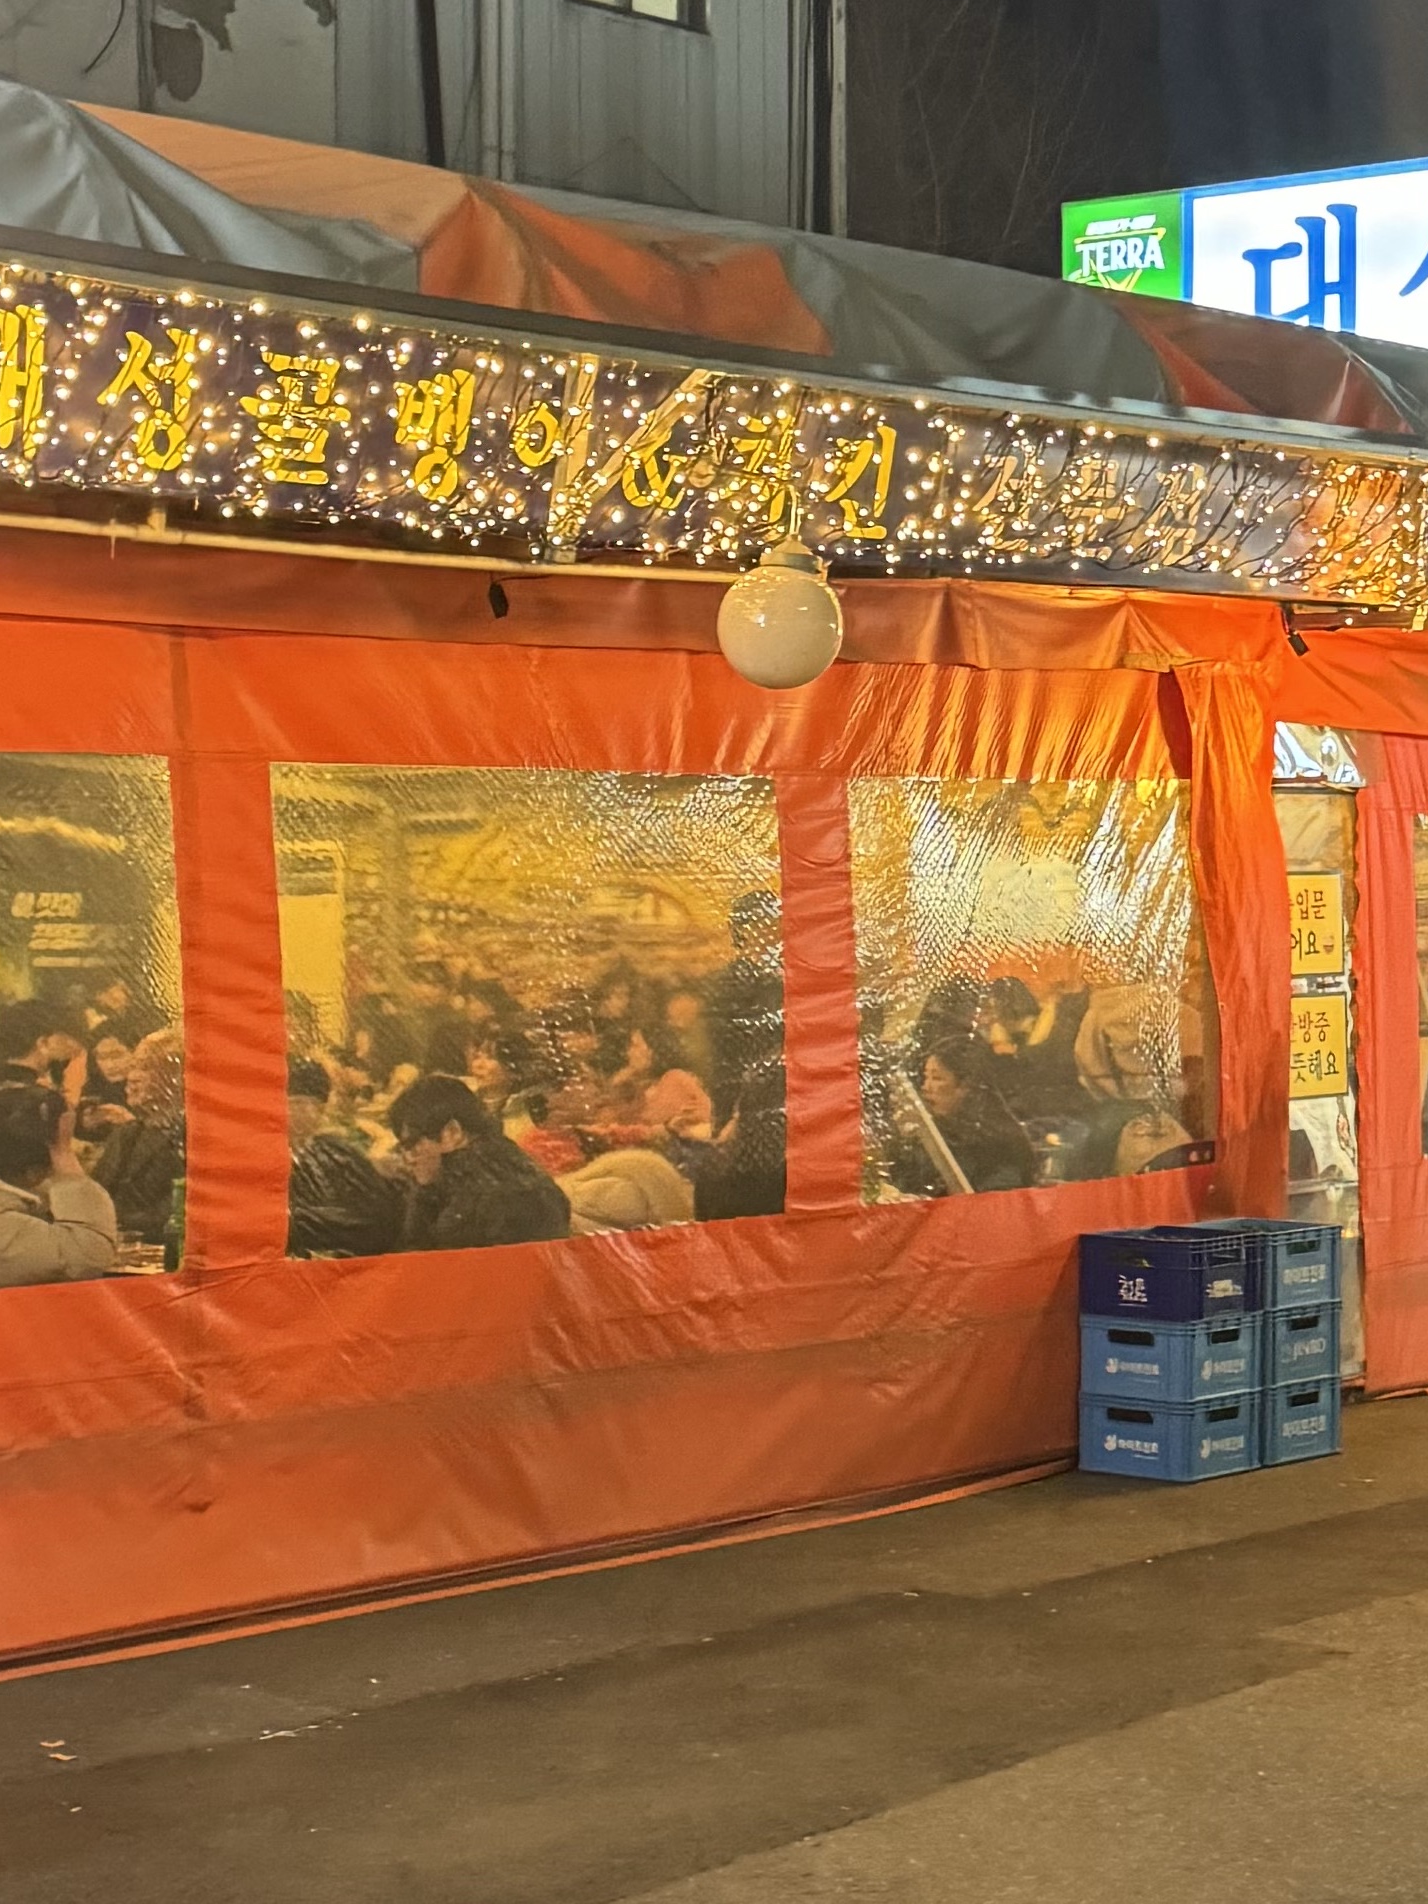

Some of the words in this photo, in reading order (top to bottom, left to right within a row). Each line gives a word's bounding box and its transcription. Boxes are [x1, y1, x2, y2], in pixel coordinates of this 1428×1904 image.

[1075, 235, 1165, 277] TERRA
[1289, 889, 1327, 920] 입문
[1290, 1010, 1331, 1044] 방중
